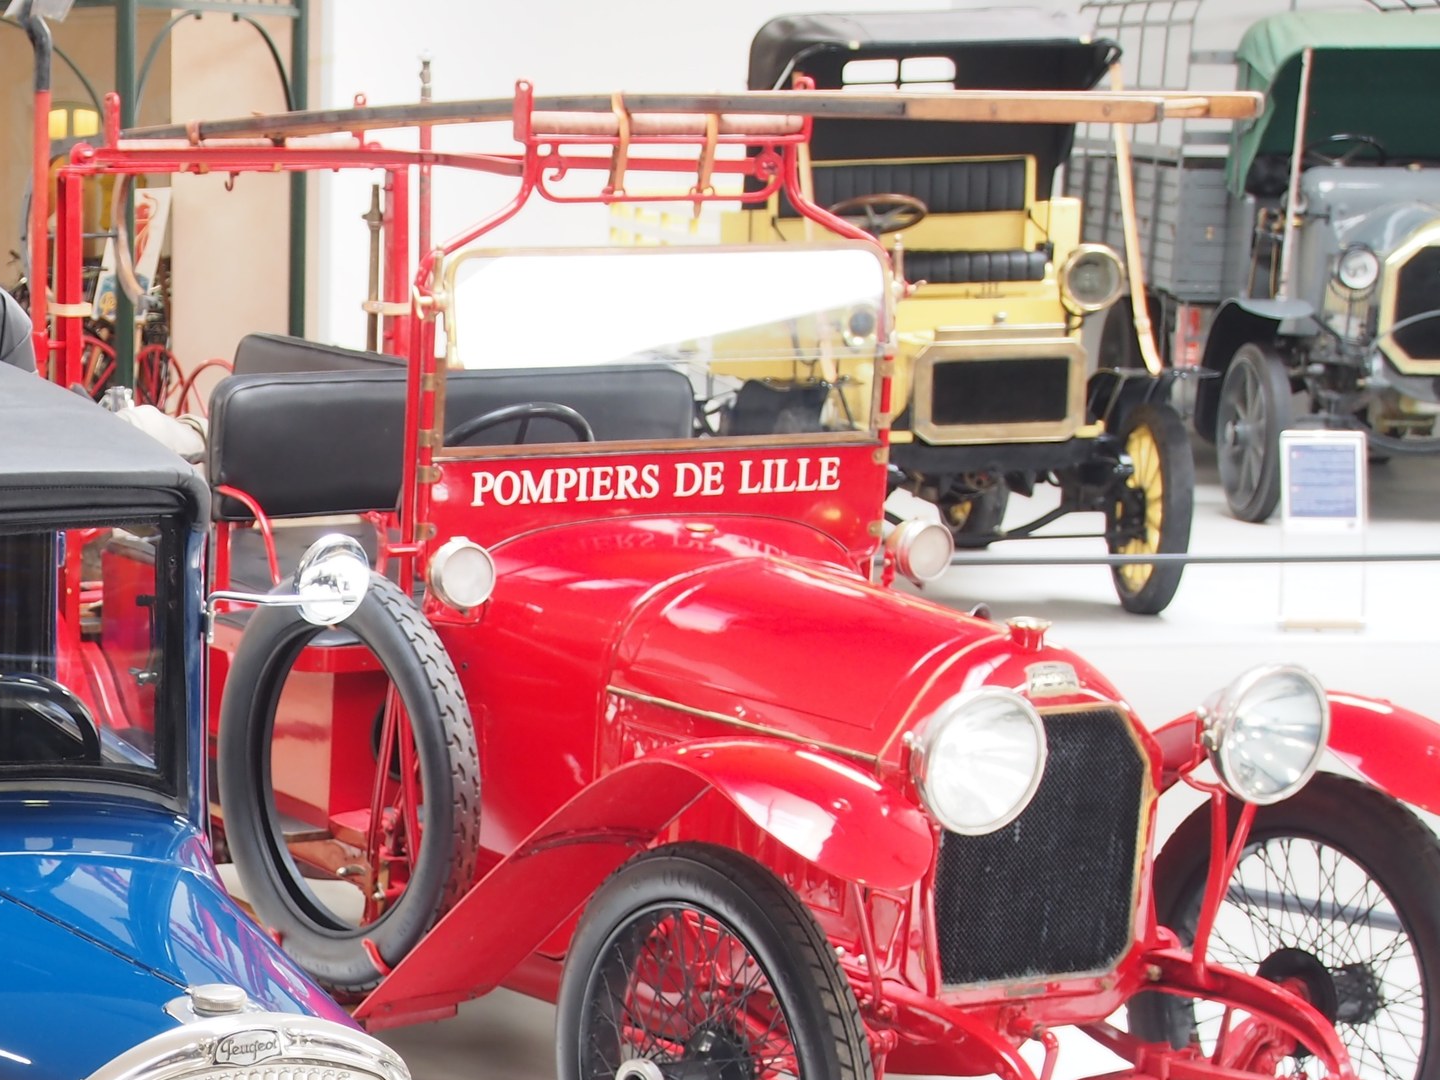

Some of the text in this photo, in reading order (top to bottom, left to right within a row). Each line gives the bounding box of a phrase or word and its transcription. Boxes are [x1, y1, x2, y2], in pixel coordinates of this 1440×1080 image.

[471, 457, 841, 506] POMPIERS DE LILLE
[220, 1040, 277, 1061] Peugeot
